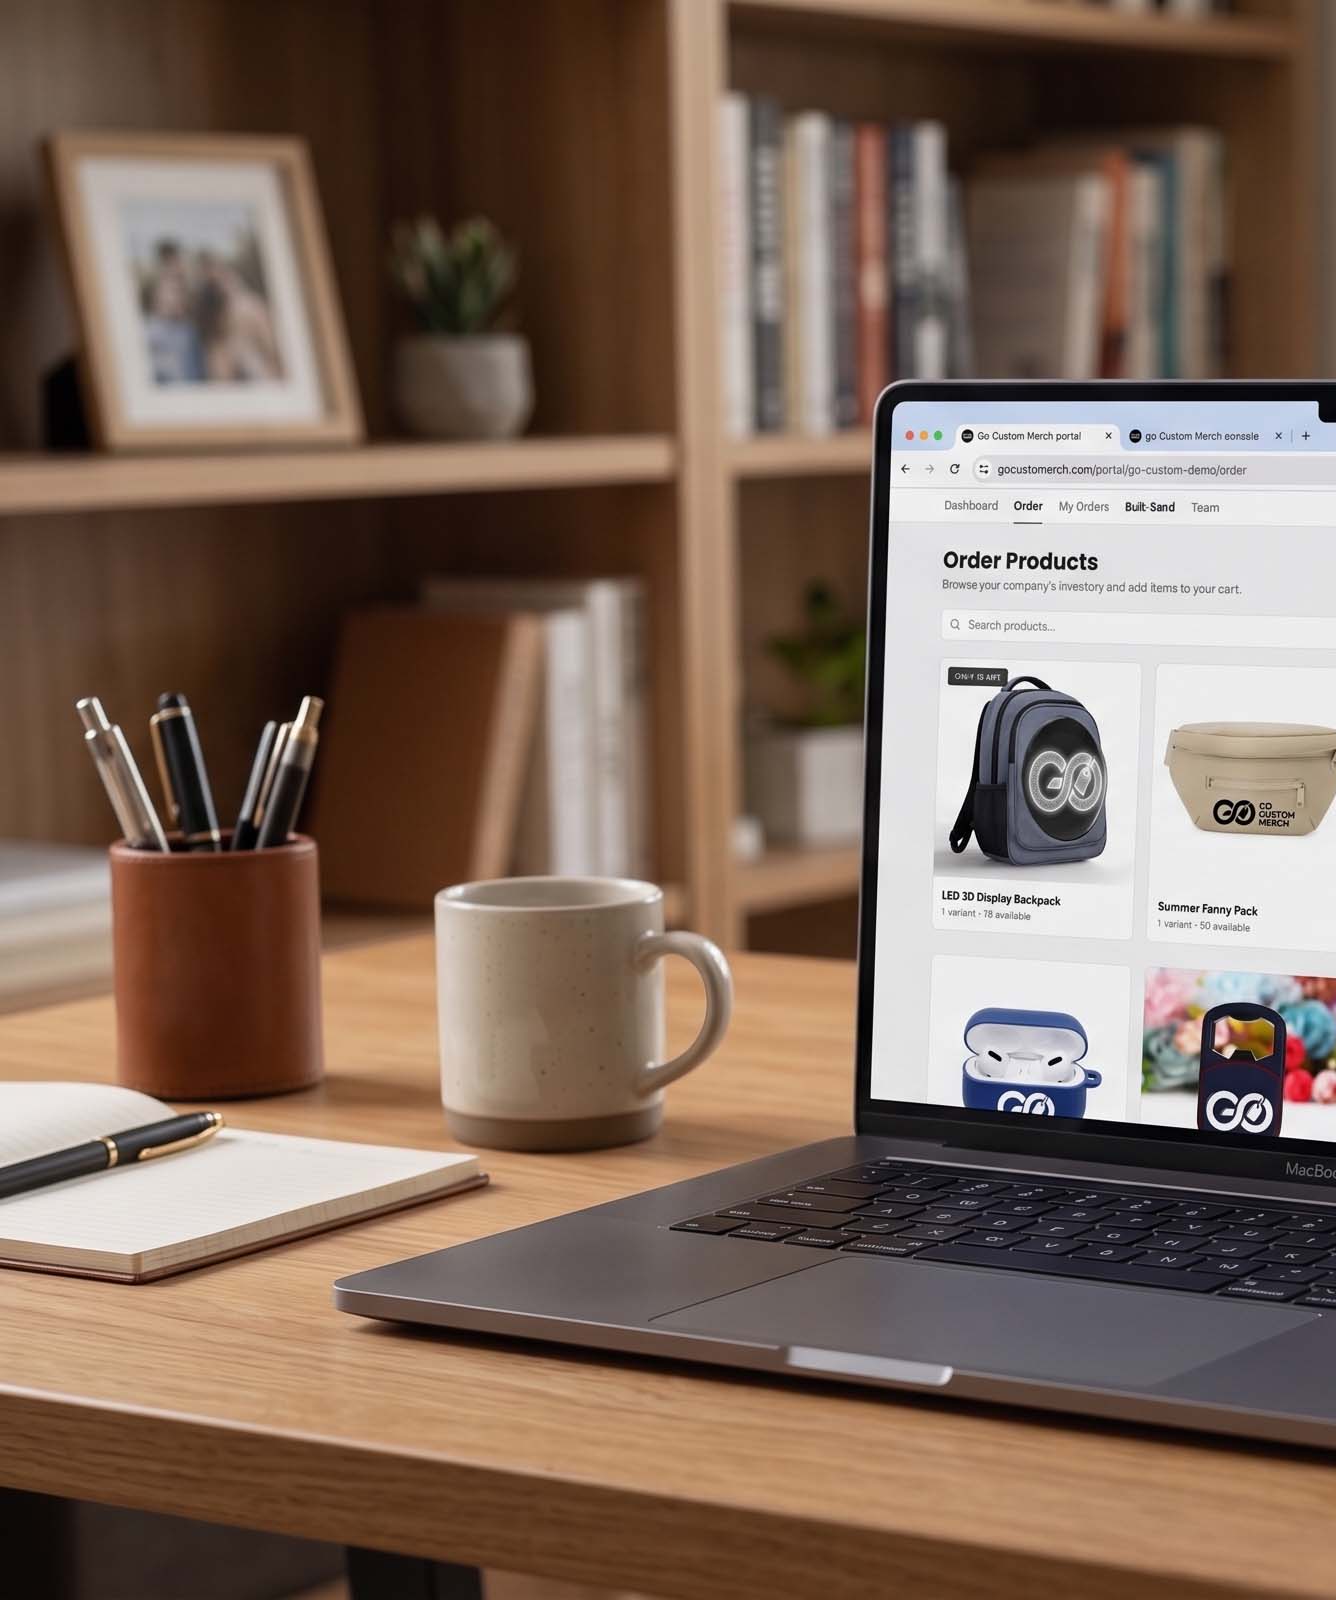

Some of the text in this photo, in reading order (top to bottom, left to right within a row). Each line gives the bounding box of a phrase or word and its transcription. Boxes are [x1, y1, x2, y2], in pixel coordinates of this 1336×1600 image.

[992, 432, 1024, 440] Custom
[1027, 432, 1053, 440] Merch
[1056, 432, 1081, 442] portal
[1146, 434, 1156, 442] go
[1159, 432, 1192, 440] Custom
[1195, 432, 1222, 440] Merch
[998, 464, 1247, 477] gocustomerch.com/portal/go-custom-demo/order
[945, 500, 998, 510] Dashboard
[1014, 501, 1043, 511] Order
[1059, 501, 1109, 513] My Orders
[1125, 502, 1175, 512] Built-Sand
[1192, 503, 1219, 512] Team
[944, 551, 1098, 570] Order Products
[942, 579, 977, 589] Browse
[979, 582, 1001, 592] your
[1003, 581, 1056, 594] company's
[1106, 582, 1126, 592] and
[1128, 582, 1147, 592] add
[1151, 582, 1178, 593] items
[1181, 584, 1190, 593] to
[1193, 585, 1216, 596] your
[1218, 585, 1242, 594] cart.
[968, 619, 1055, 632] Search products...
[1259, 819, 1289, 827] MERCH
[942, 890, 1061, 907] LED 3D Display Backpack
[948, 909, 976, 917] variant
[984, 910, 993, 918] 78
[995, 912, 1031, 920] available
[1158, 902, 1258, 917] Summer Fanny Pack
[1164, 920, 1192, 928] variant
[1200, 921, 1211, 930] 50
[1213, 923, 1250, 932] available
